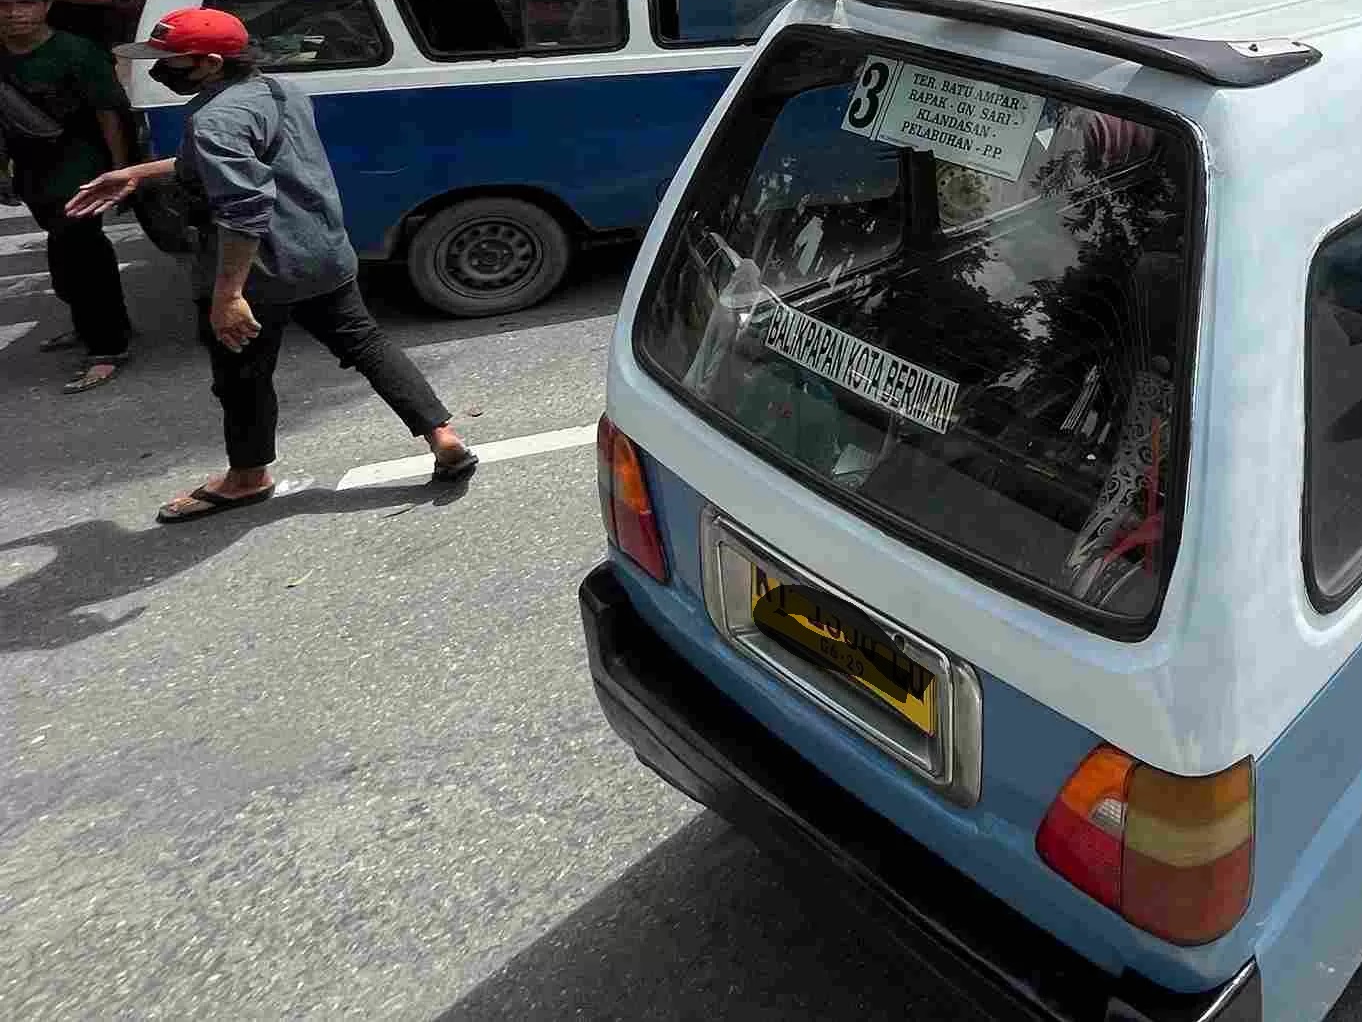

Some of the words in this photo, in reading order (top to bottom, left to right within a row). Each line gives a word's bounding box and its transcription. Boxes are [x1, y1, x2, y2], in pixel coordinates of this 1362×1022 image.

[849, 63, 890, 128] 3
[908, 89, 949, 109] RAPAK
[981, 107, 1012, 126] SARI
[913, 73, 937, 90] TER.
[941, 80, 975, 98] BATU
[976, 89, 1020, 111] AMPAR
[901, 121, 974, 151] PELABUHAN
[917, 108, 991, 138] KLANDASAN
[767, 305, 851, 379] BALIKPAPAN
[844, 342, 884, 400] KOTA
[881, 360, 958, 431] BERIMAN
